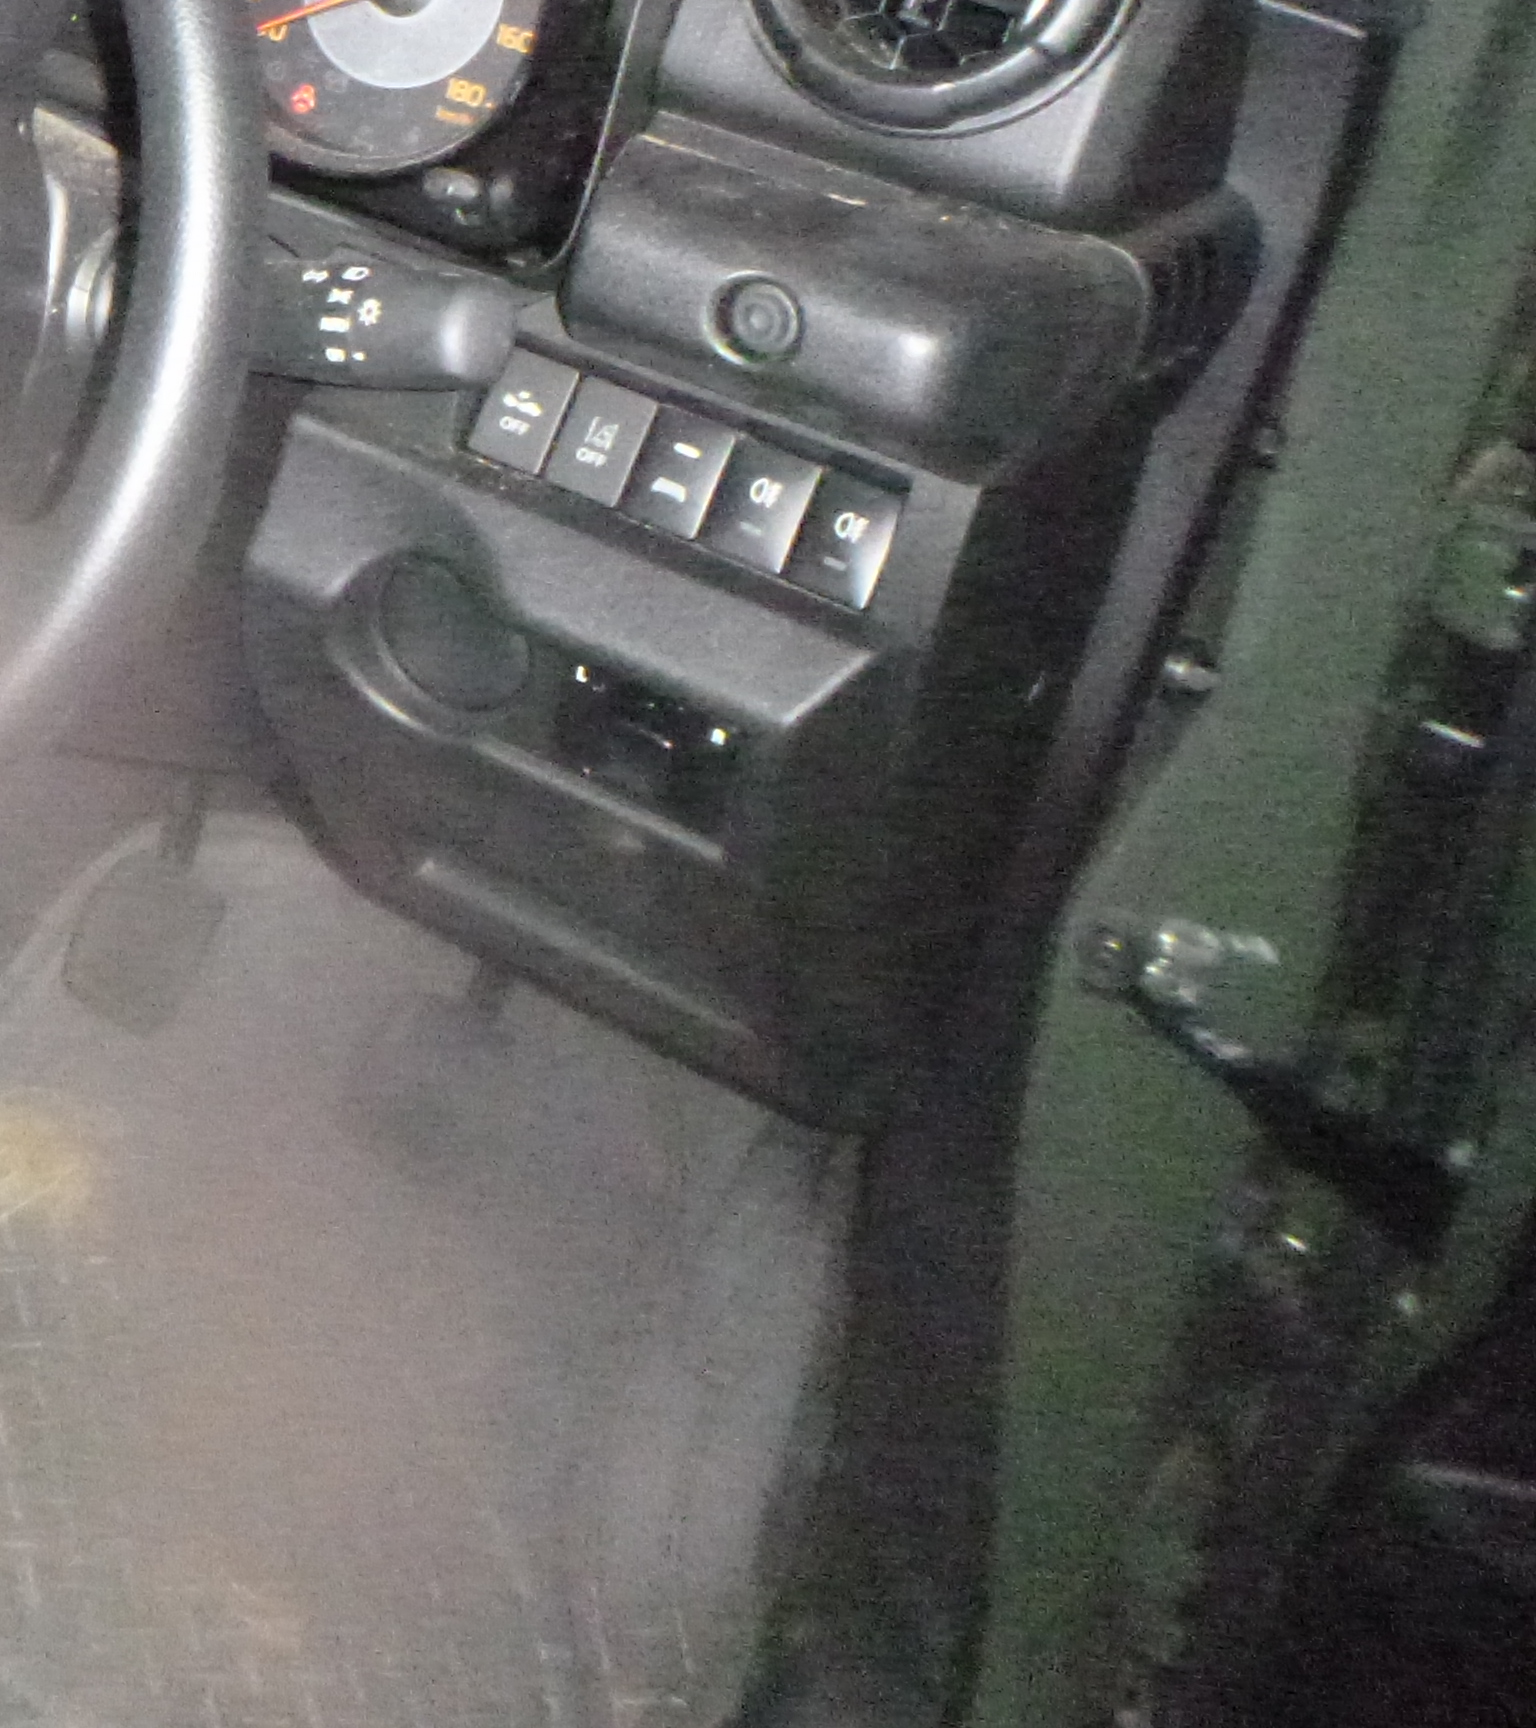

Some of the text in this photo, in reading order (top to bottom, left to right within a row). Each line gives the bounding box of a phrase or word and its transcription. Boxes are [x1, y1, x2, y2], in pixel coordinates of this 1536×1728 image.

[496, 24, 538, 54] 160
[446, 77, 487, 108] 180
[499, 415, 531, 436] OFF
[575, 446, 608, 467] OFF
